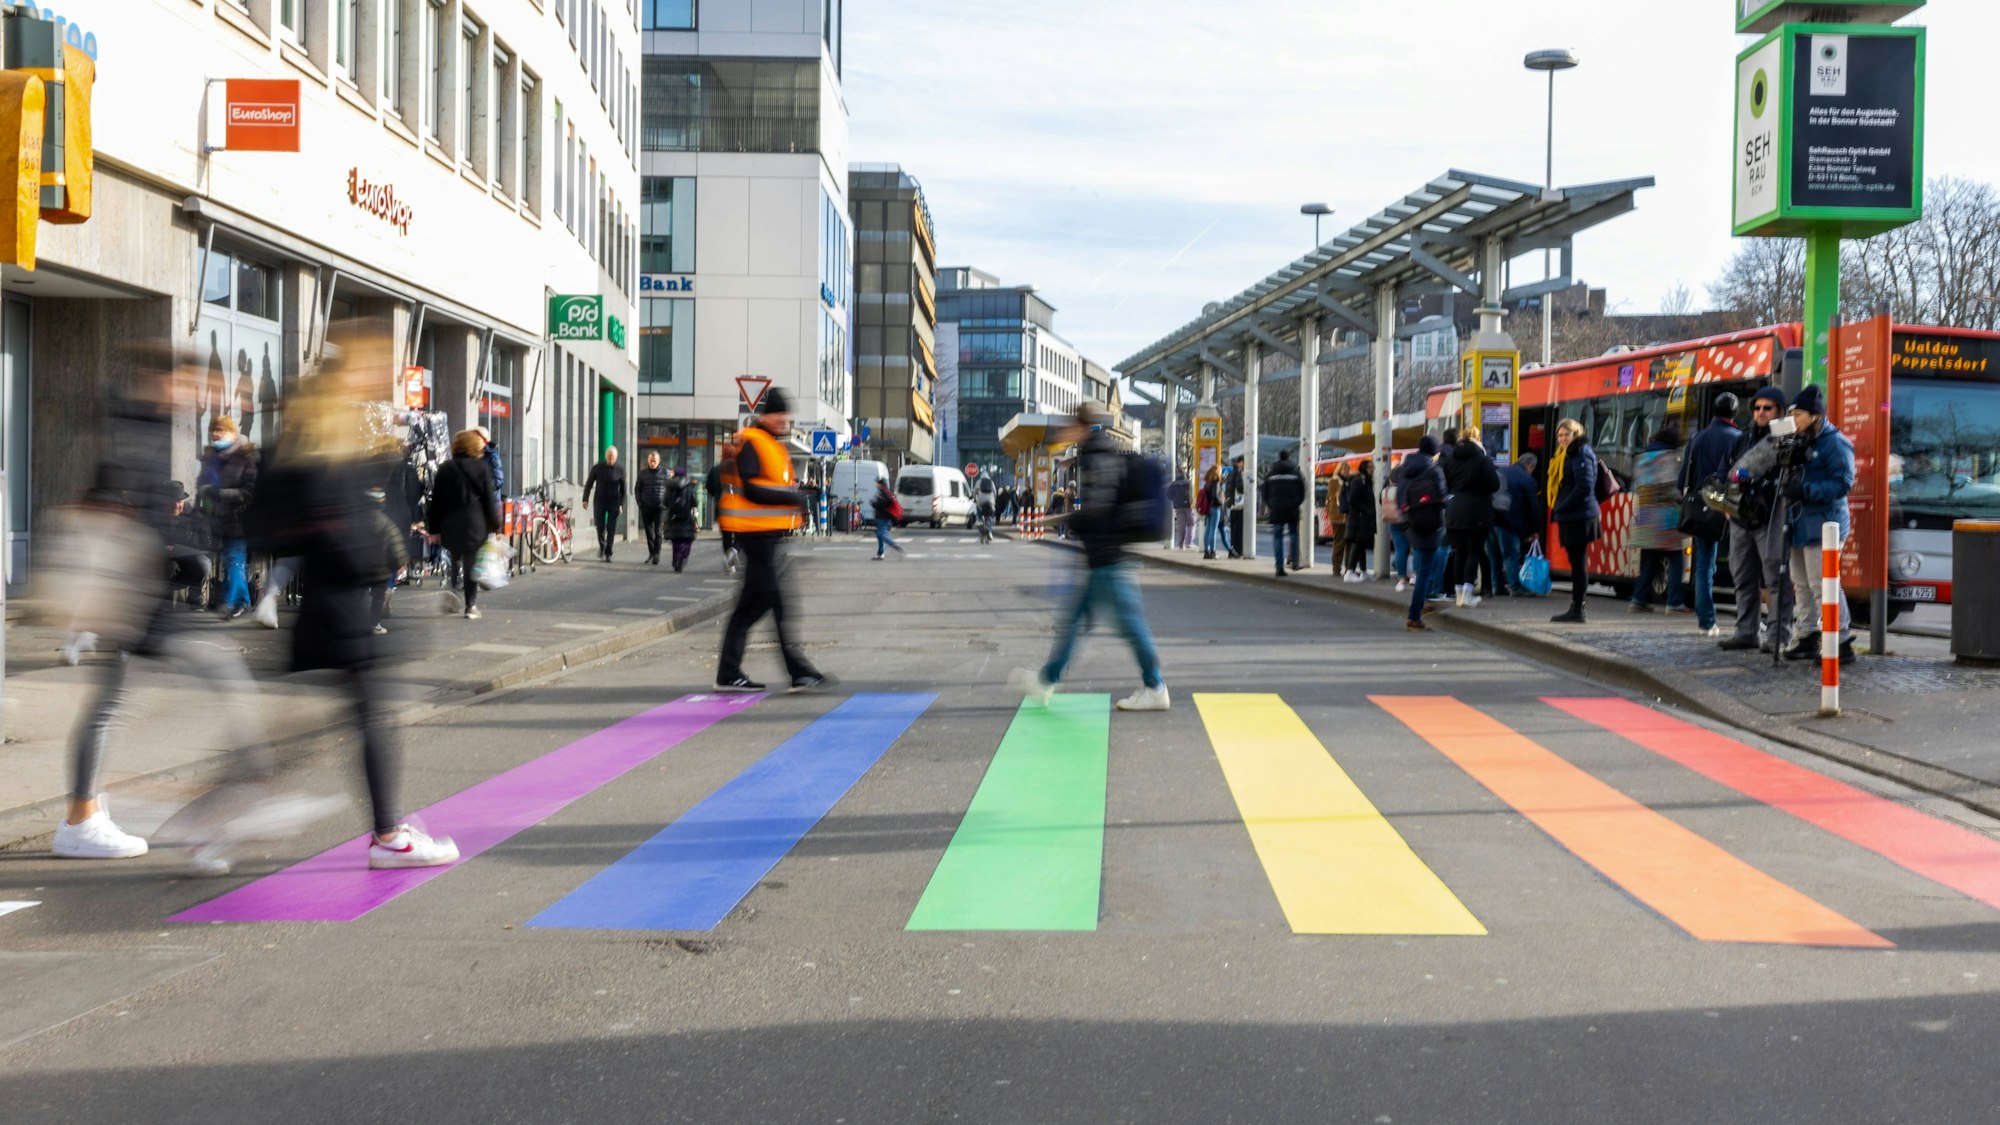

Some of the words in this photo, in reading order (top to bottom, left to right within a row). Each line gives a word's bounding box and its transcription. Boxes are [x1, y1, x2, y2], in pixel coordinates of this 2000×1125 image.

[1817, 66, 1841, 77] SEH
[1809, 107, 1829, 116] Alles
[1829, 107, 1840, 116] für
[1840, 107, 1855, 117] den
[1818, 116, 1831, 125] der
[1831, 117, 1858, 126] Bonner
[1745, 130, 1770, 167] SEH
[1848, 147, 1867, 157] Optik
[1868, 147, 1891, 156] GmbH
[1749, 163, 1766, 185] RAU
[1808, 164, 1826, 173] Ecke
[1826, 164, 1851, 173] Bonner
[640, 276, 693, 291] Bank
[559, 323, 599, 337] Bank
[1904, 340, 1959, 355] Waldau
[1891, 353, 1987, 371] Poppelsdorf
[1488, 369, 1509, 385] A1
[1203, 428, 1216, 437] A1
